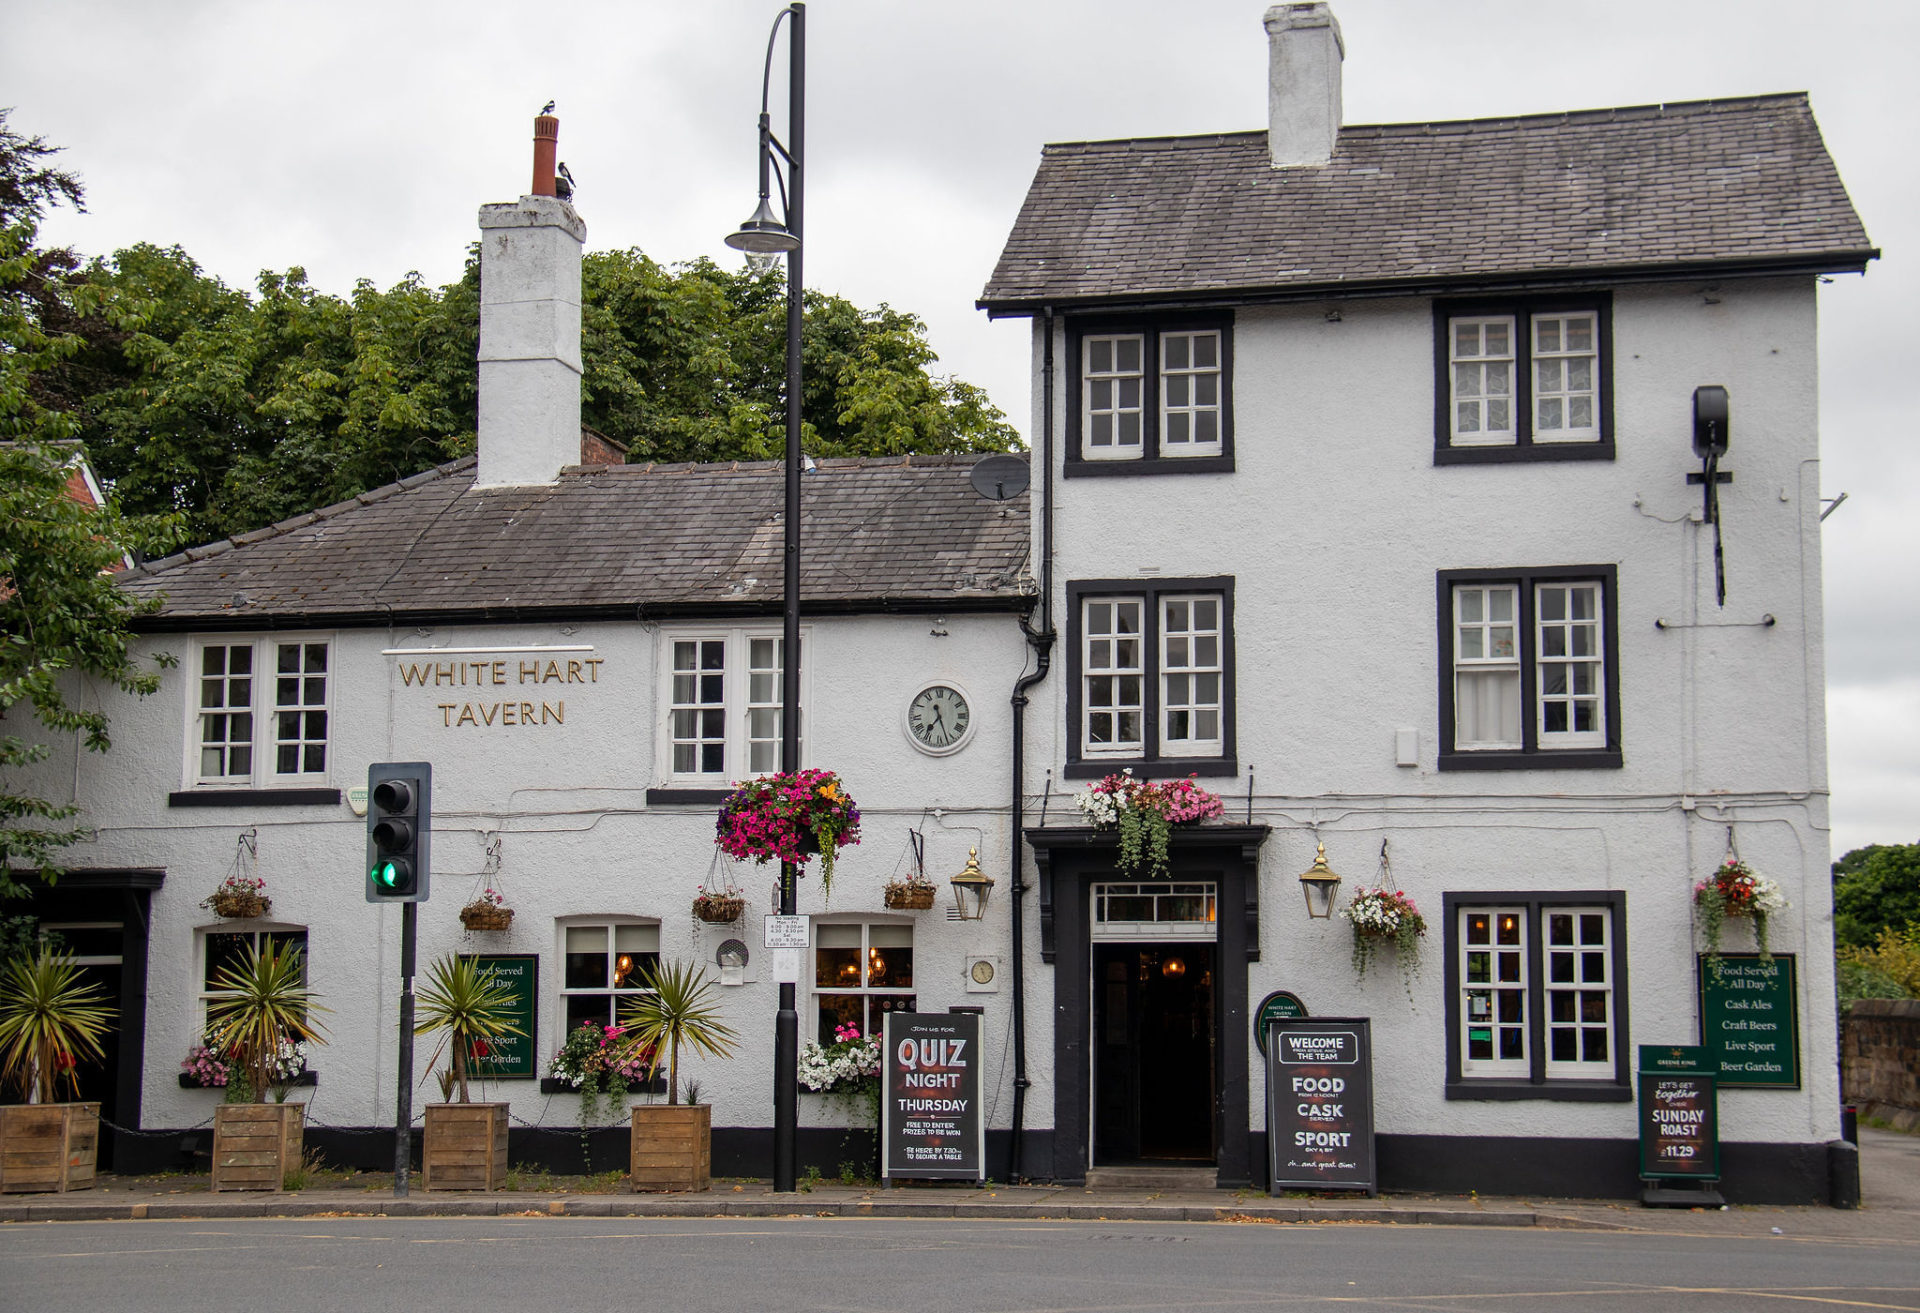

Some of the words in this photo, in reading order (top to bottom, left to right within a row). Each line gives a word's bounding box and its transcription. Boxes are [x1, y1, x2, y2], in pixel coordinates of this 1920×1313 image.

[399, 660, 506, 686] WHITE
[520, 658, 604, 684] HART
[438, 700, 564, 726] TAVERN
[495, 966, 522, 976] Served
[1718, 966, 1742, 976] Food
[1744, 966, 1778, 976] Served
[496, 979, 512, 989] Day
[1730, 979, 1744, 989] All
[1747, 980, 1766, 991] Day
[1725, 1000, 1749, 1009] Cask
[1751, 1000, 1772, 1010] Ales
[1722, 1020, 1747, 1030] Craft
[1749, 1021, 1777, 1030] Beers
[494, 1036, 517, 1045] Sport
[1288, 1038, 1344, 1048] WELCOME
[1725, 1041, 1746, 1050] Live
[1748, 1042, 1775, 1053] Sport
[490, 1054, 521, 1063] Garden
[898, 1038, 967, 1070] QUIZ
[1720, 1062, 1743, 1071] Beer
[1745, 1062, 1782, 1072] Garden
[905, 1074, 960, 1088] NIGHT
[1292, 1077, 1345, 1092] FOOD
[1655, 1089, 1699, 1103] together
[898, 1099, 967, 1112] THURSDAY
[1297, 1104, 1344, 1117] CASK
[1652, 1110, 1704, 1123] SUNDAY
[1660, 1124, 1697, 1136] ROAST
[1295, 1132, 1351, 1147] SPORT
[1318, 1161, 1336, 1170] great
